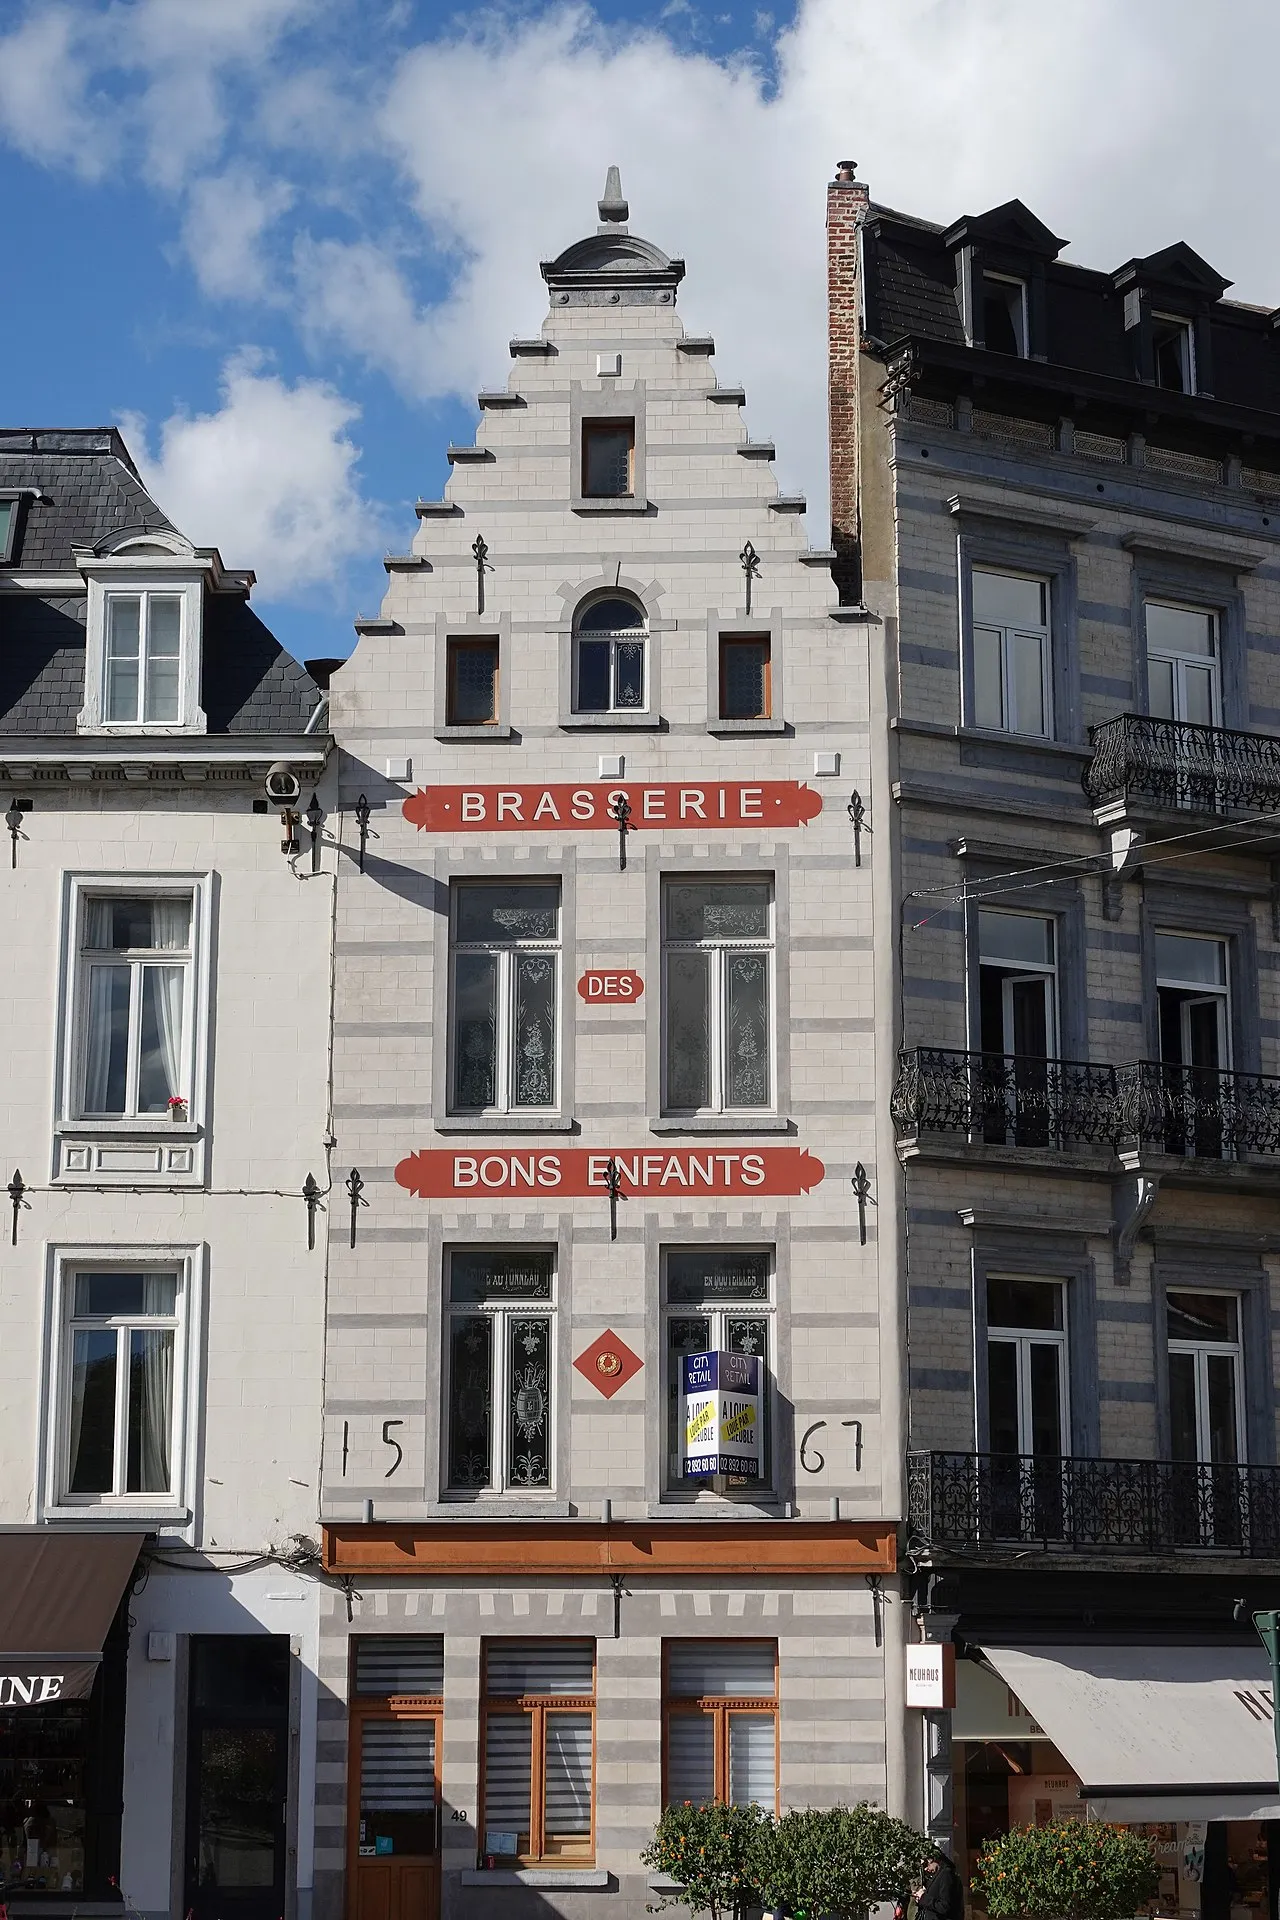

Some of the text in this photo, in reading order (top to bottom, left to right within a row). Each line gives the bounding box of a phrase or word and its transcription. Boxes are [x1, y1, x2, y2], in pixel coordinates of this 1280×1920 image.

[461, 788, 764, 822] BRASSERIE
[587, 976, 634, 996] DES
[453, 1154, 767, 1188] BONS ENFANTS
[693, 1356, 709, 1369] CITY
[730, 1356, 747, 1370] CITY
[688, 1370, 712, 1384] RETAIL
[725, 1370, 751, 1385] RETAIL
[909, 1668, 939, 1681] NEUHAUS
[451, 1810, 467, 1822] 49
